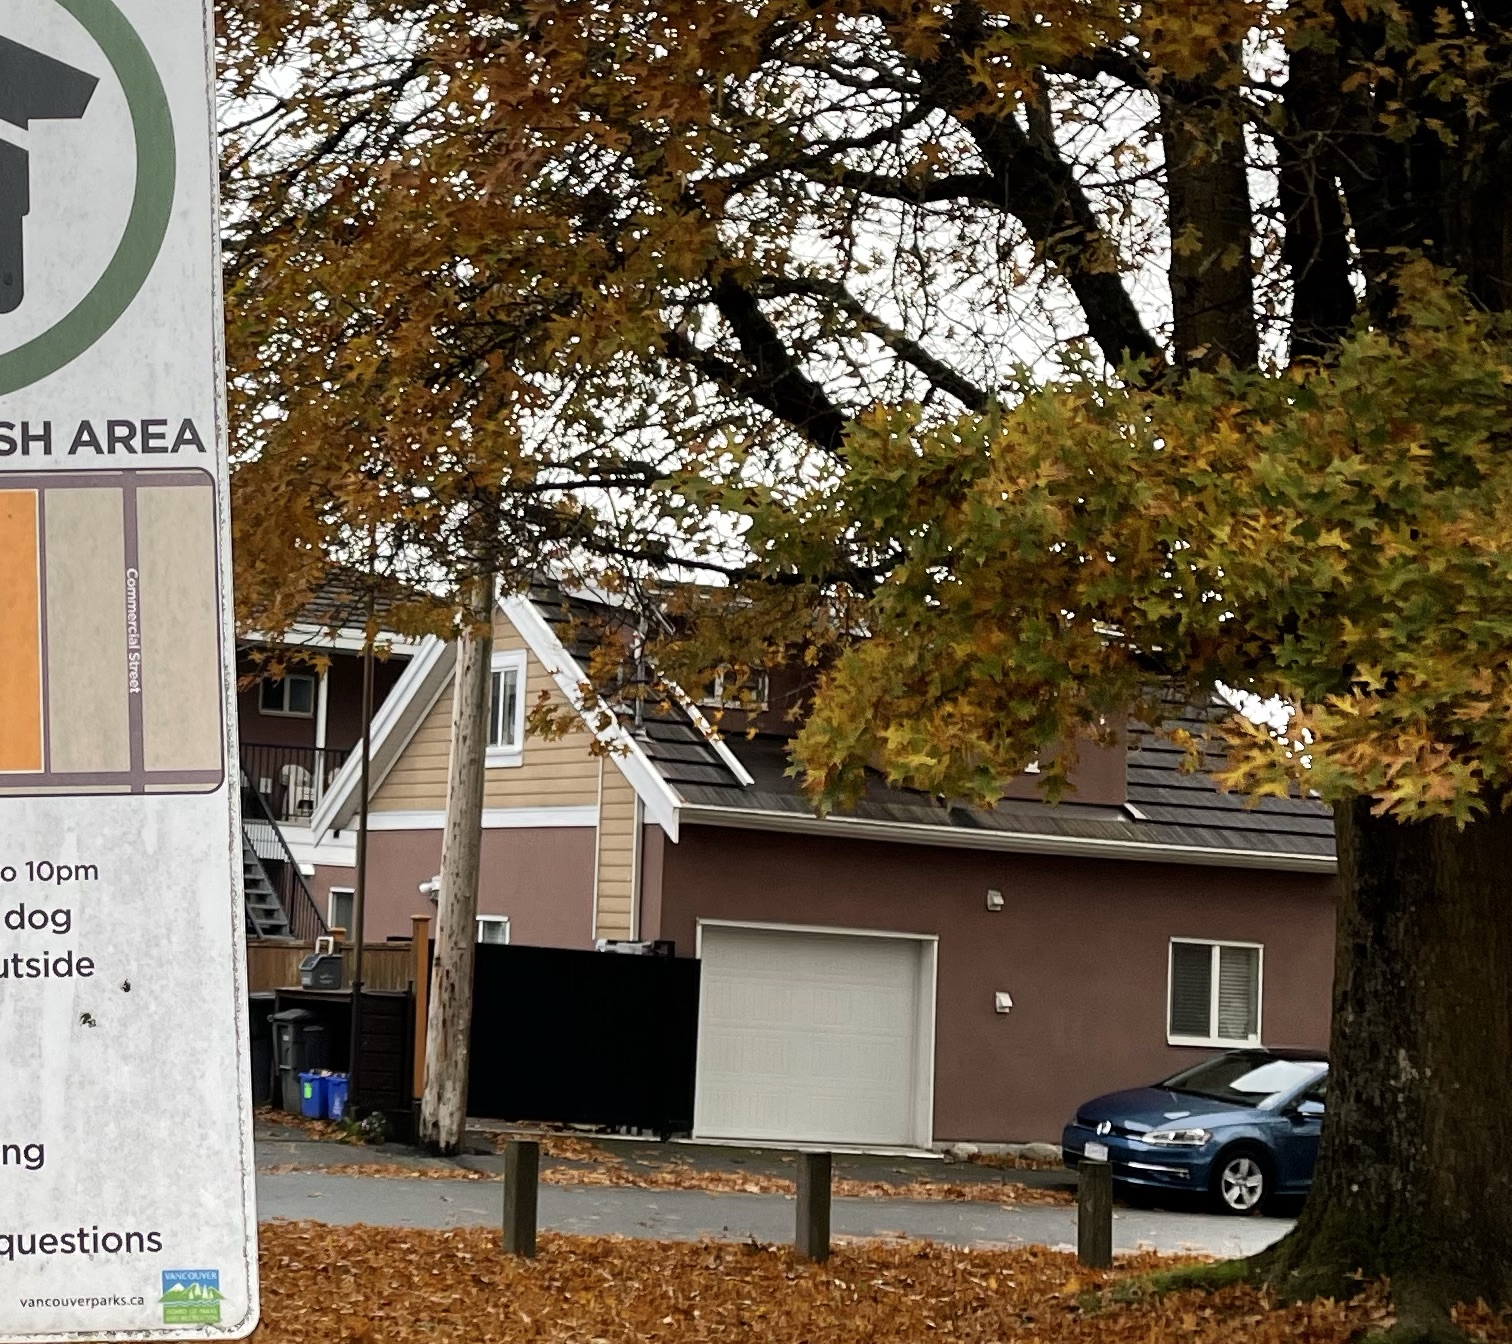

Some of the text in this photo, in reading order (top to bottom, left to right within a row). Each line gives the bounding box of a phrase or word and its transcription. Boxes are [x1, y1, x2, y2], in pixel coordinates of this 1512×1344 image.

[68, 418, 206, 455] AREA
[127, 567, 141, 693] Commercial Street
[26, 861, 98, 885] 10pm
[5, 903, 71, 934] dog
[164, 1271, 218, 1281] VANCOUVER
[20, 1294, 145, 1309] vancouverparks.ca
